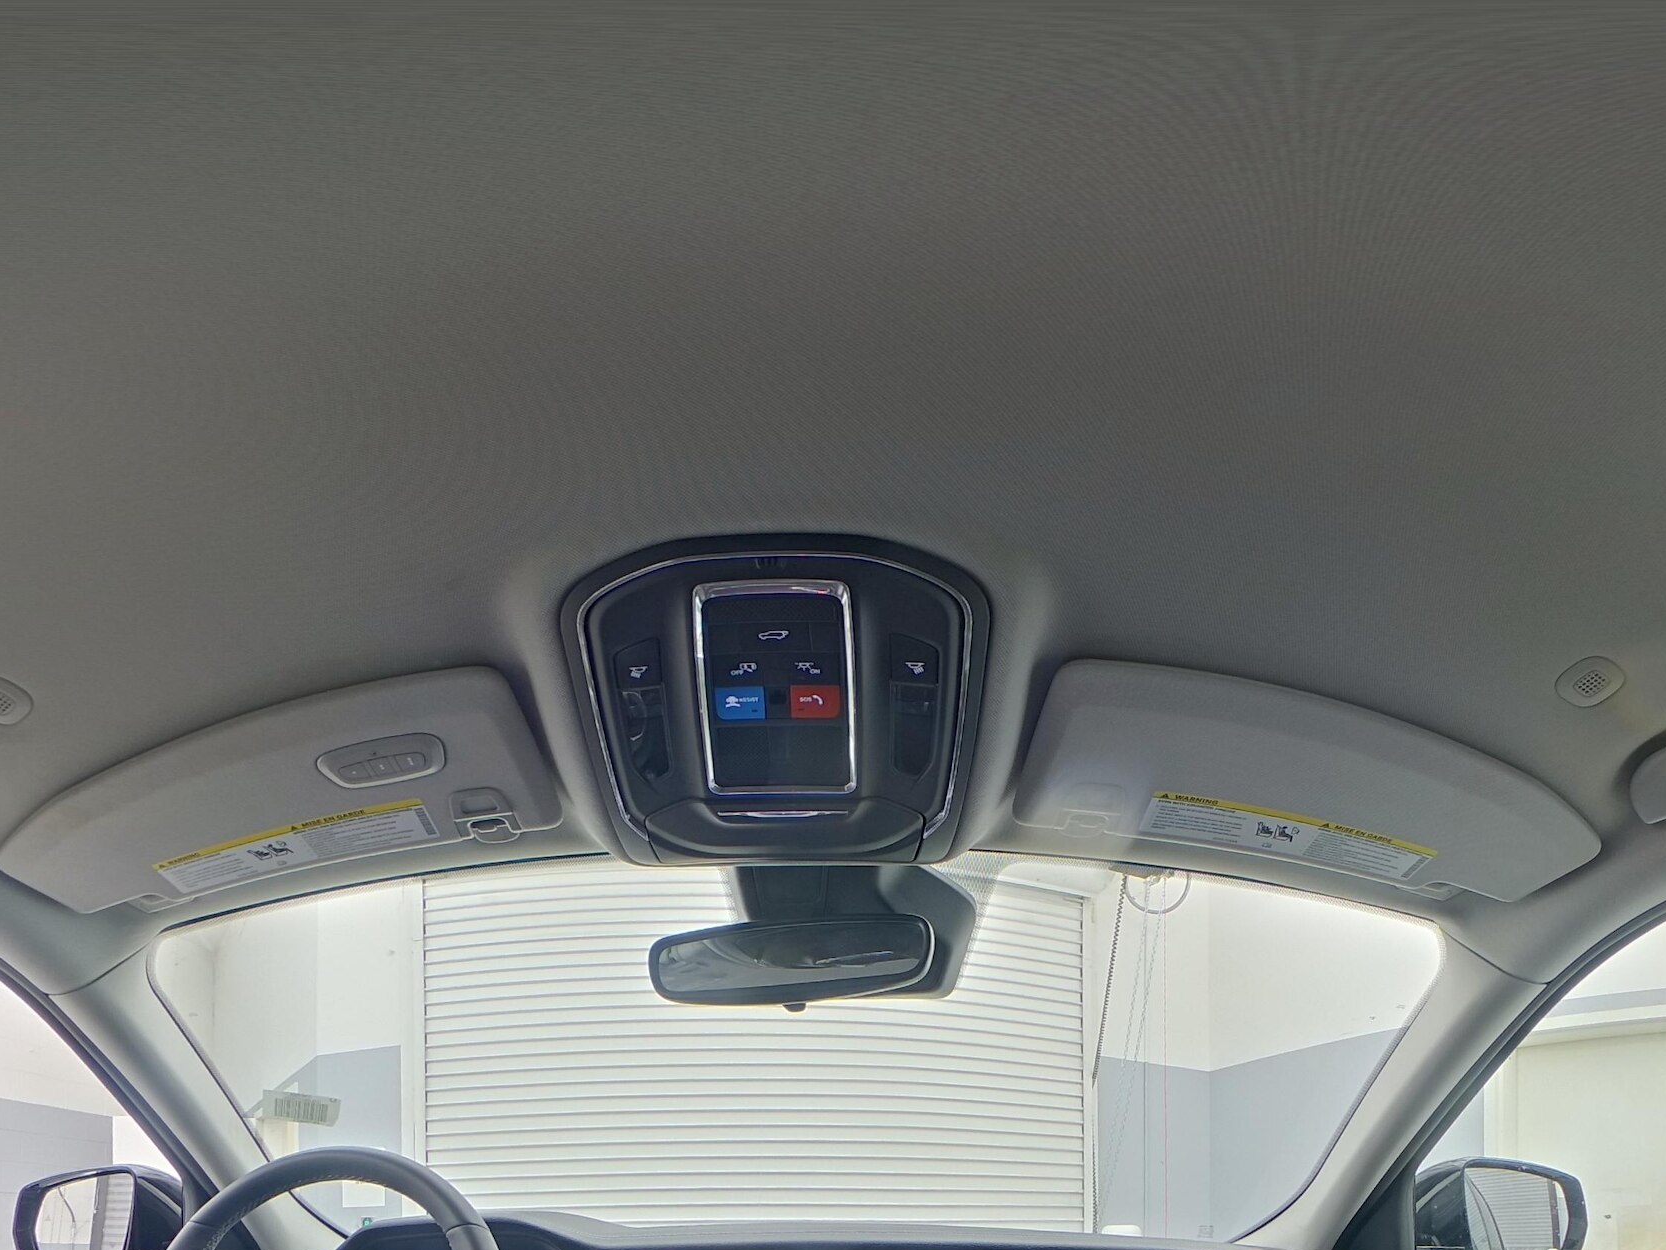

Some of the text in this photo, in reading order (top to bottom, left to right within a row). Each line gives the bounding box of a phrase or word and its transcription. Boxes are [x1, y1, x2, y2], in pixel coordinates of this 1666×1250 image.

[1174, 794, 1219, 806] WARNING
[301, 809, 366, 828] MISE EN GARDE
[1334, 825, 1354, 833] MISE
[1367, 833, 1393, 844] GARDE
